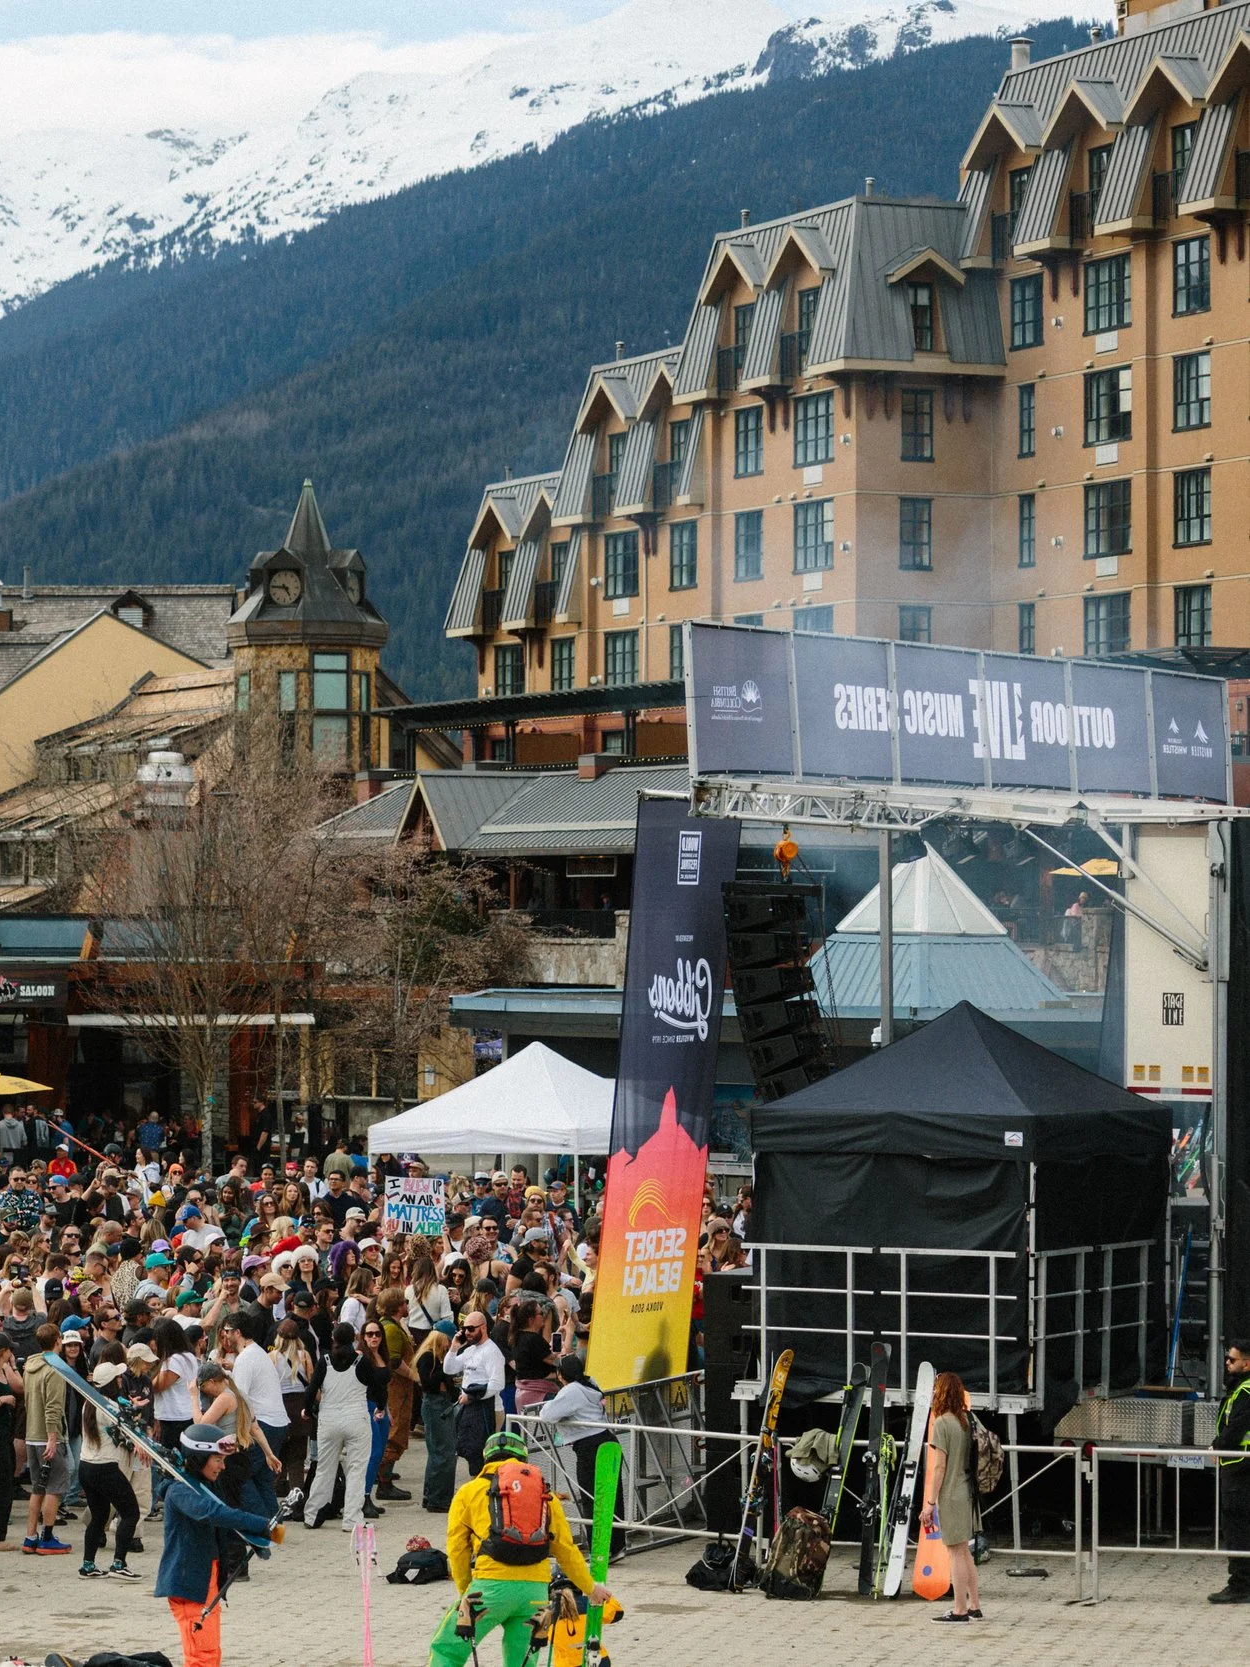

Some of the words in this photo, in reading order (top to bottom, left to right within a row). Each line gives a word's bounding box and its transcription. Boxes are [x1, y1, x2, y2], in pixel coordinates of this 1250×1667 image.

[20, 986, 55, 997] SALOON
[1163, 994, 1184, 1009] STAGE
[1163, 1009, 1184, 1025] LINE
[388, 1179, 401, 1190] I
[433, 1180, 442, 1195] UP
[399, 1194, 416, 1205] AN
[418, 1195, 435, 1206] AIR
[388, 1203, 445, 1222] MATTRESS
[402, 1221, 413, 1233] IN
